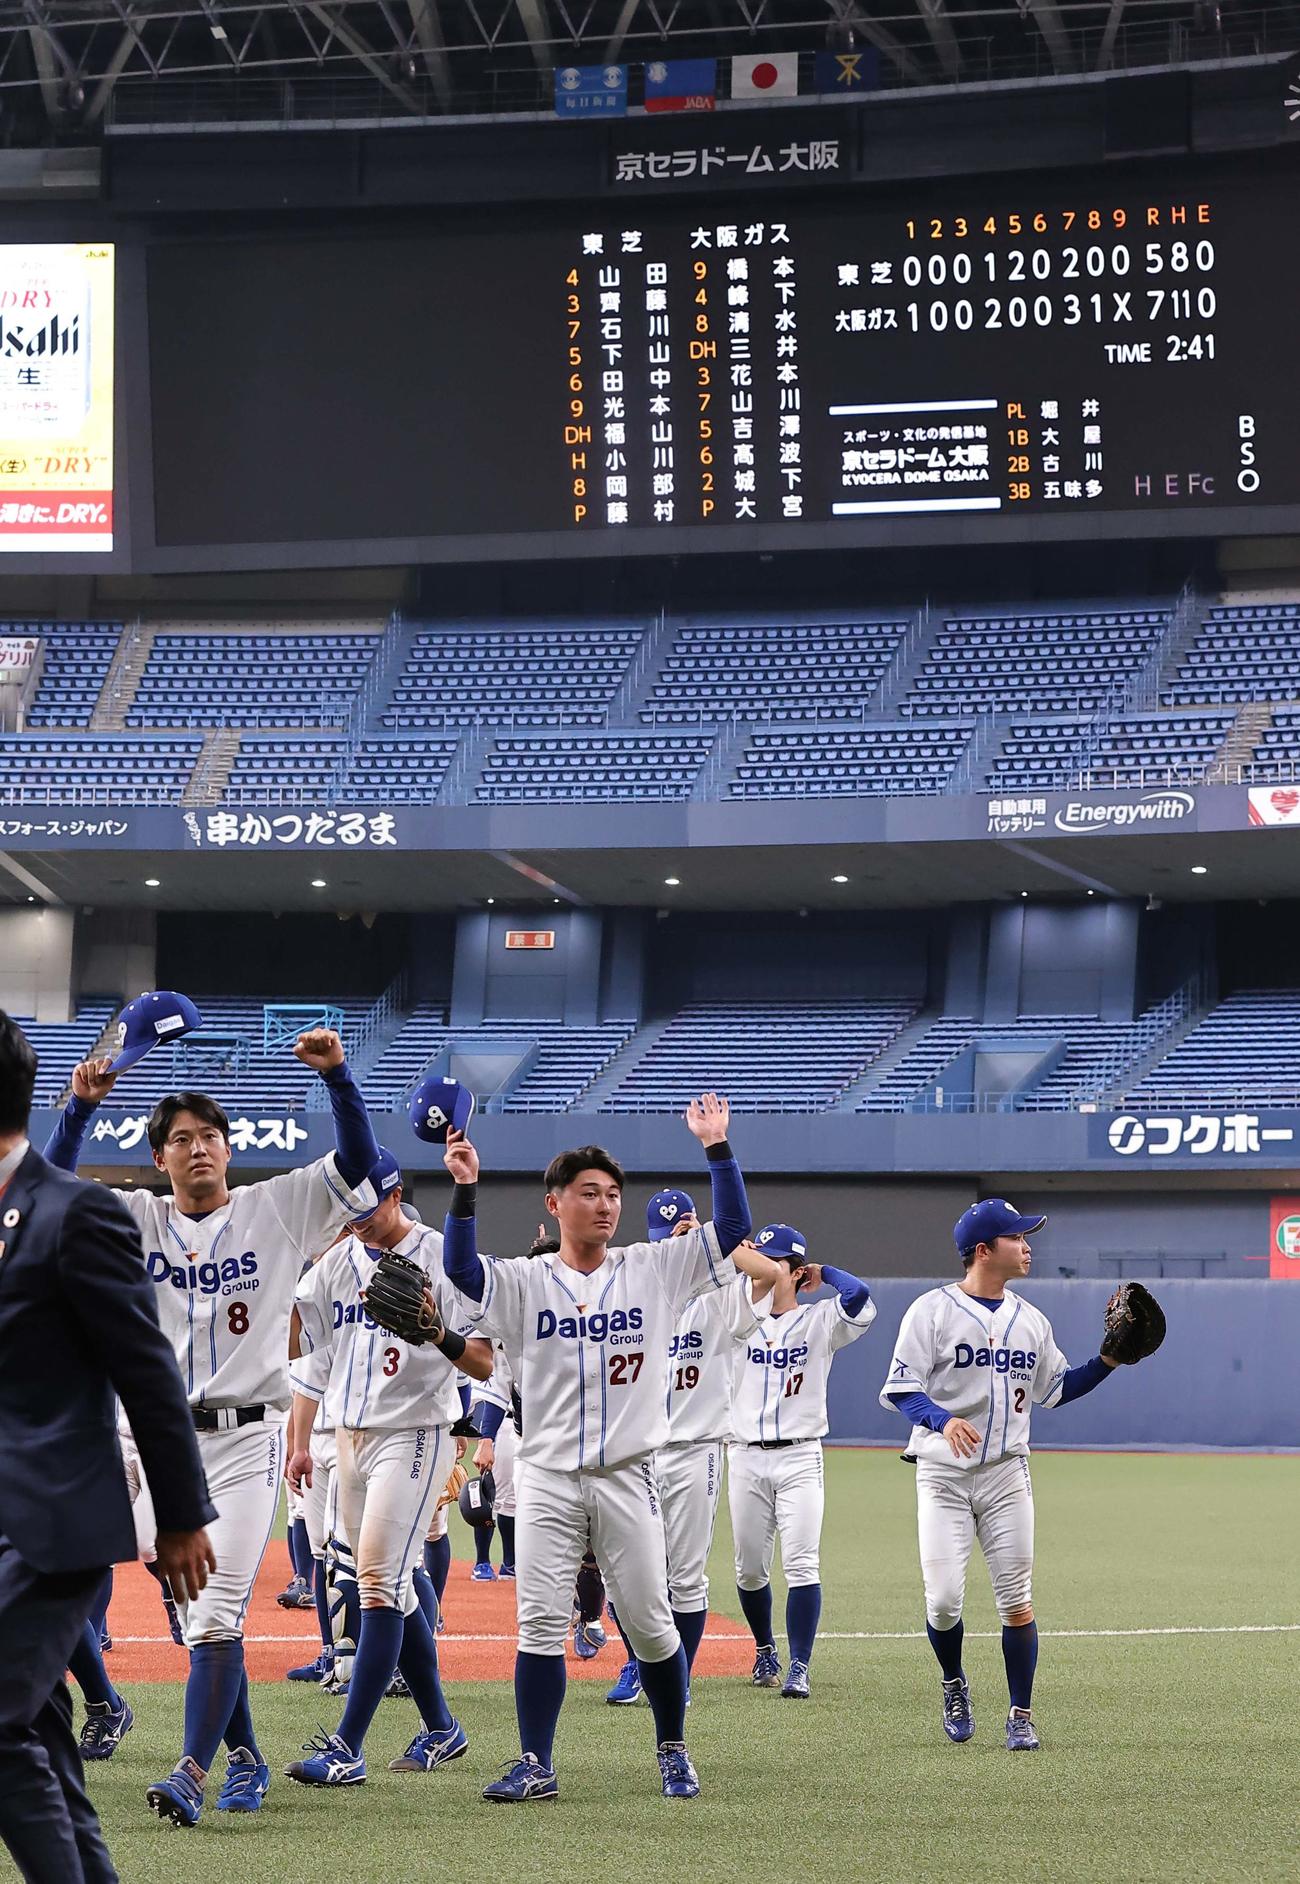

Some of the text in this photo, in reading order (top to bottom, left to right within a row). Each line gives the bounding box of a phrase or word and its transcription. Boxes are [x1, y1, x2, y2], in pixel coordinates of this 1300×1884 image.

[907, 205, 1209, 238] 1 2 3 4 5 6 7 8 9 R H E
[583, 231, 642, 254] 東芝
[691, 223, 789, 248] 大阪ガス
[567, 263, 666, 286] 4 山田
[694, 262, 706, 279] 9
[838, 262, 892, 285] 東芝
[568, 295, 579, 312] 3
[696, 289, 707, 305] 4
[569, 315, 669, 339] 7 石川
[696, 315, 708, 332] 8
[835, 308, 897, 332] 大阪ガス
[570, 342, 669, 365] 5 下山
[690, 335, 797, 359] DH 三井
[1104, 334, 1214, 363] TIME 2:41
[17, 367, 41, 385] 生
[570, 368, 670, 392] 6 田中
[699, 362, 798, 385] 3 花本
[571, 400, 583, 417] 9
[699, 388, 800, 411] 7 山川
[1008, 399, 1099, 419] PL 堀井
[565, 421, 672, 444] DH 福山
[701, 420, 711, 438] 5
[1008, 430, 1028, 445] 1B
[572, 447, 673, 471] H 小川
[701, 447, 712, 464] 6
[1008, 452, 1102, 472] 2B 古川
[574, 479, 585, 496] 8
[703, 473, 713, 490] 2
[842, 469, 990, 486] KYOCERA DOME OSAKA
[1009, 479, 1102, 499] 3B 五味多
[1135, 475, 1150, 496] H
[1166, 475, 1179, 495] E
[575, 505, 586, 522] P
[703, 500, 714, 516] P
[987, 798, 1046, 815] 自動車用
[1065, 800, 1184, 825] Energywith
[206, 811, 398, 846] 串かつだるま
[987, 817, 1046, 833] バッテリー
[147, 1251, 258, 1294] Daigas
[221, 1278, 260, 1296] Group
[227, 1301, 250, 1335] 8
[536, 1307, 643, 1342] Daigas
[610, 1333, 644, 1346] Group
[383, 1347, 400, 1377] 3
[676, 1350, 704, 1361] Group
[953, 1343, 1037, 1373] Daigas
[608, 1352, 645, 1386] 27
[674, 1365, 700, 1391] 19
[784, 1372, 804, 1398] 17
[1014, 1387, 1026, 1414] 2
[266, 1433, 277, 1488] OSAKA GAS
[410, 1428, 426, 1480] OSAKA GAS
[707, 1452, 715, 1479] OSAKA
[648, 1496, 658, 1516] GAS
